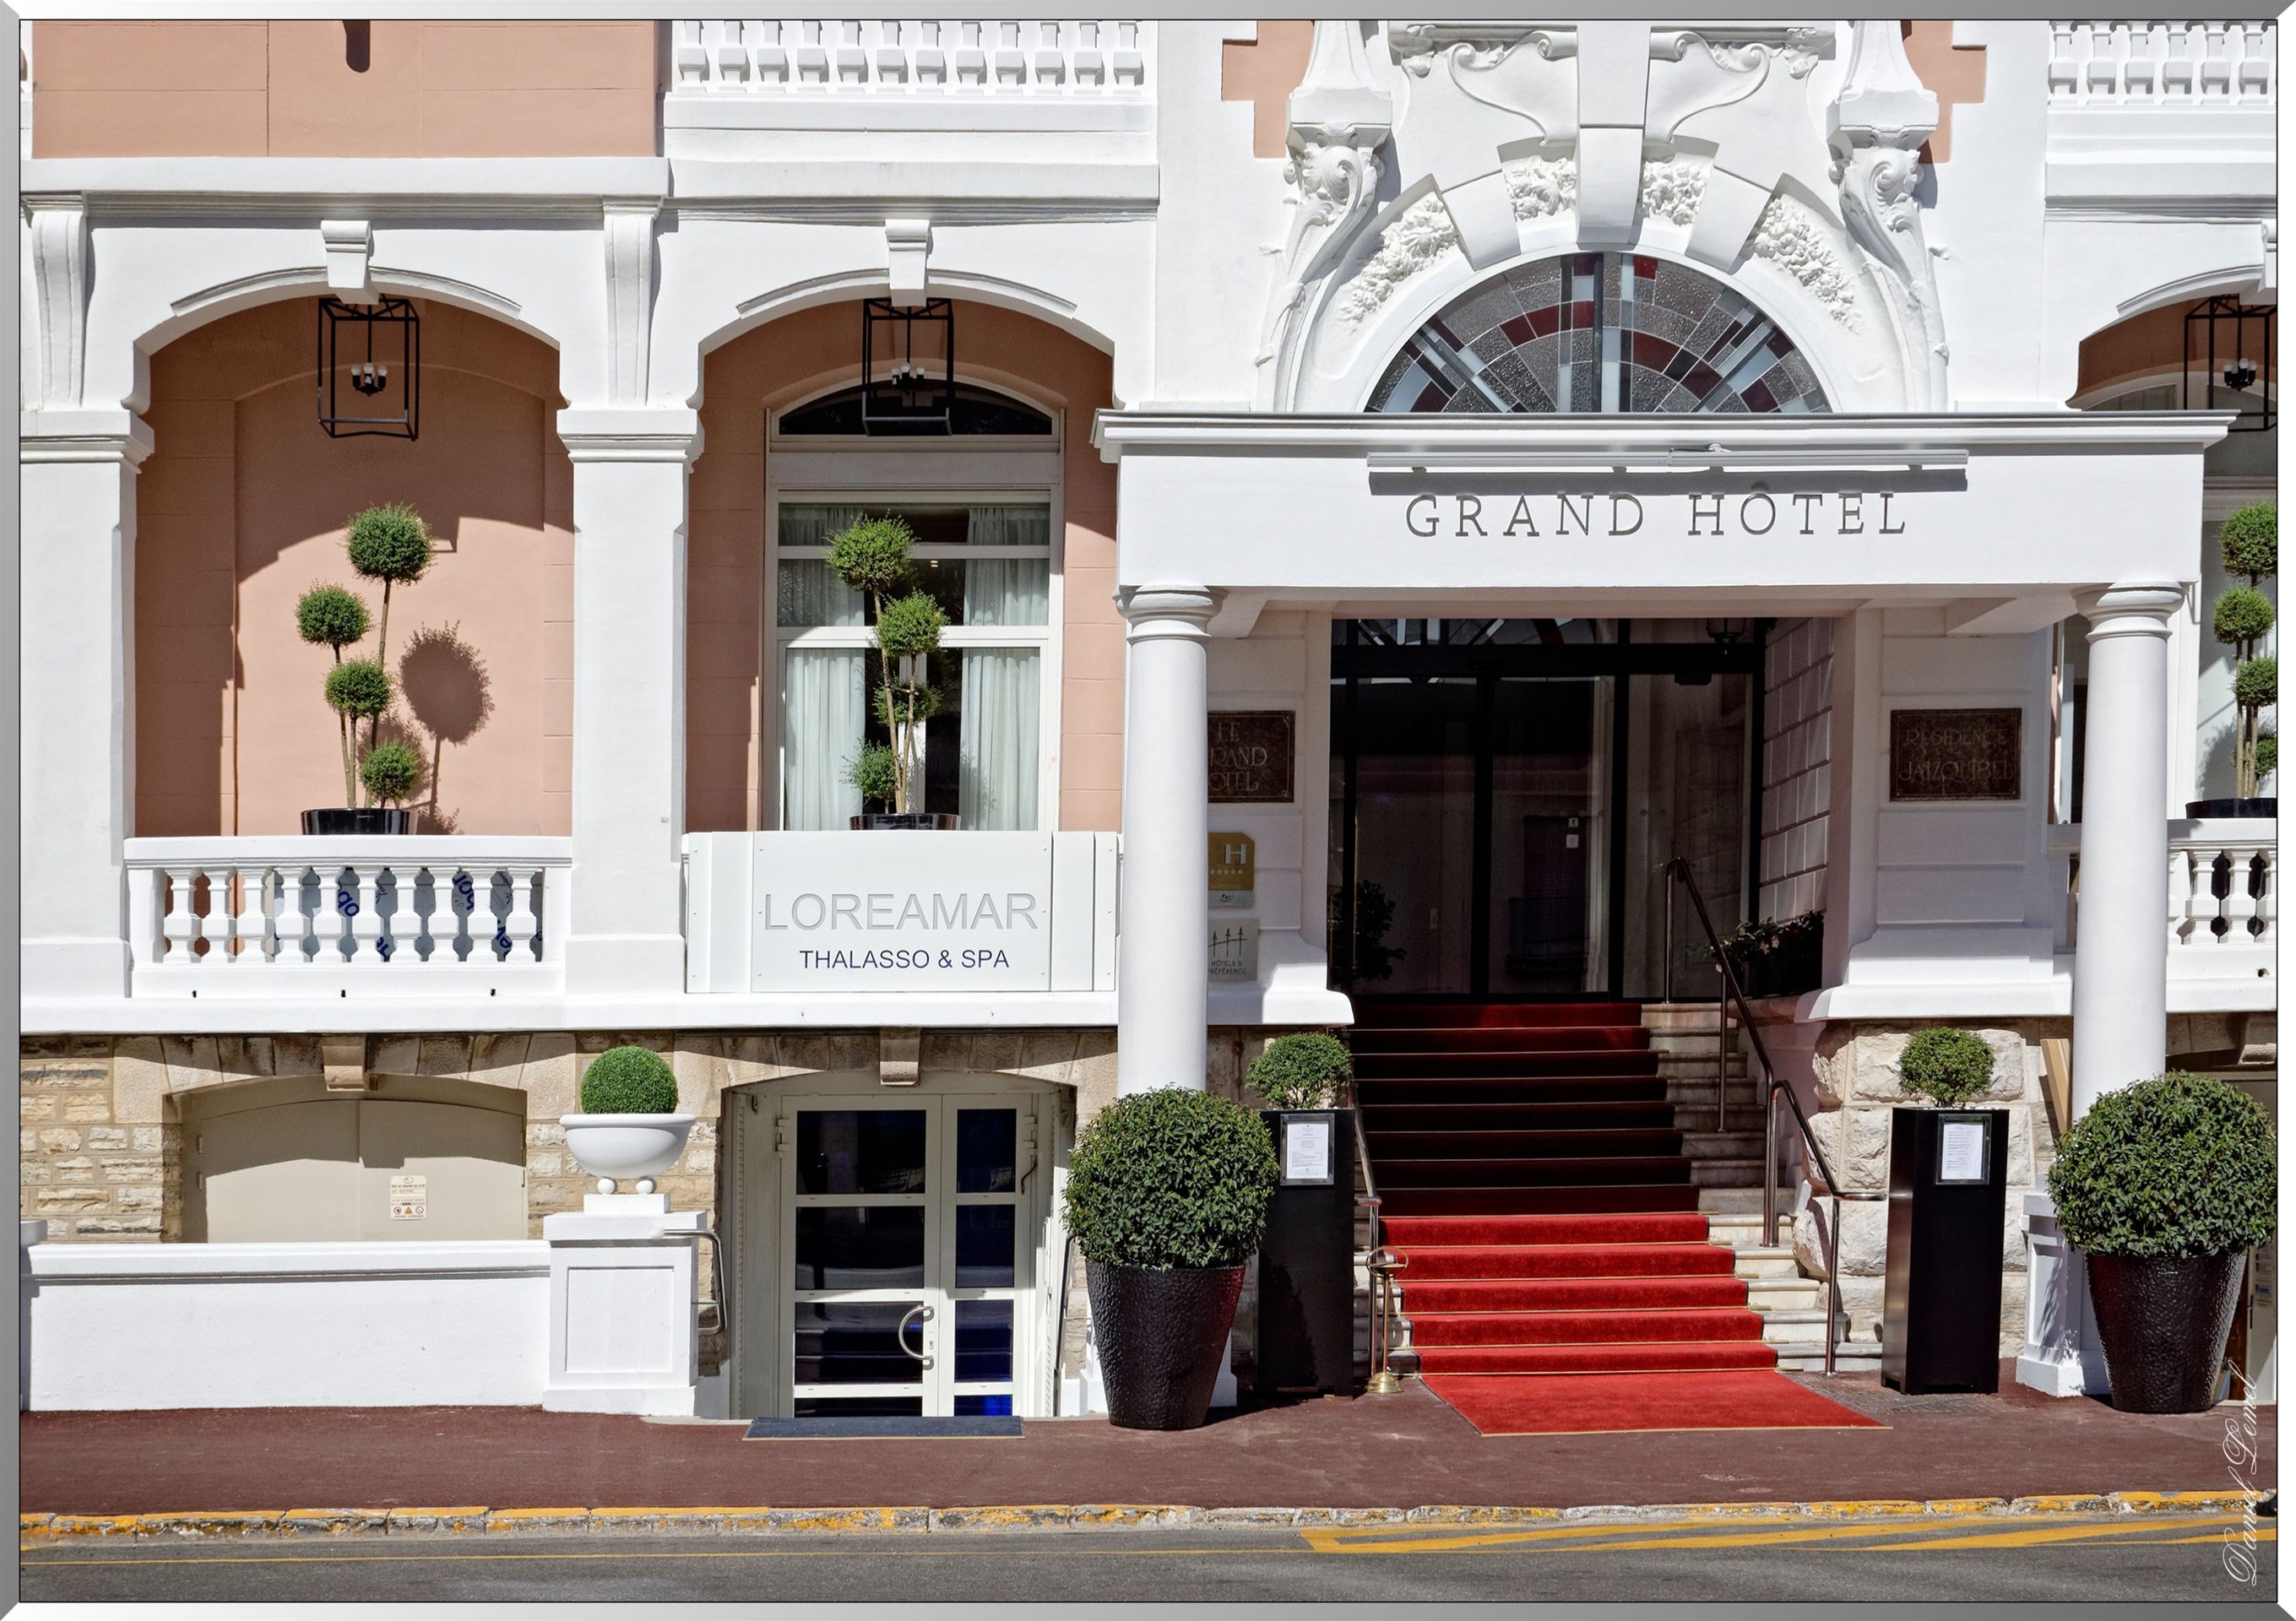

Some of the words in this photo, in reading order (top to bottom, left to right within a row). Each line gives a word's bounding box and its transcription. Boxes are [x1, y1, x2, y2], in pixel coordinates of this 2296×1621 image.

[1405, 493, 1644, 538] GRAND
[1687, 480, 1906, 537] HÔTEL
[1217, 721, 1240, 742] LE
[1208, 746, 1267, 770] RAND
[1208, 771, 1259, 792] OTEL
[1224, 843, 1247, 865] H
[763, 892, 1039, 931] LOREAMAR
[799, 949, 930, 970] THALASSO
[936, 950, 953, 969] &
[960, 950, 1010, 969] SPA
